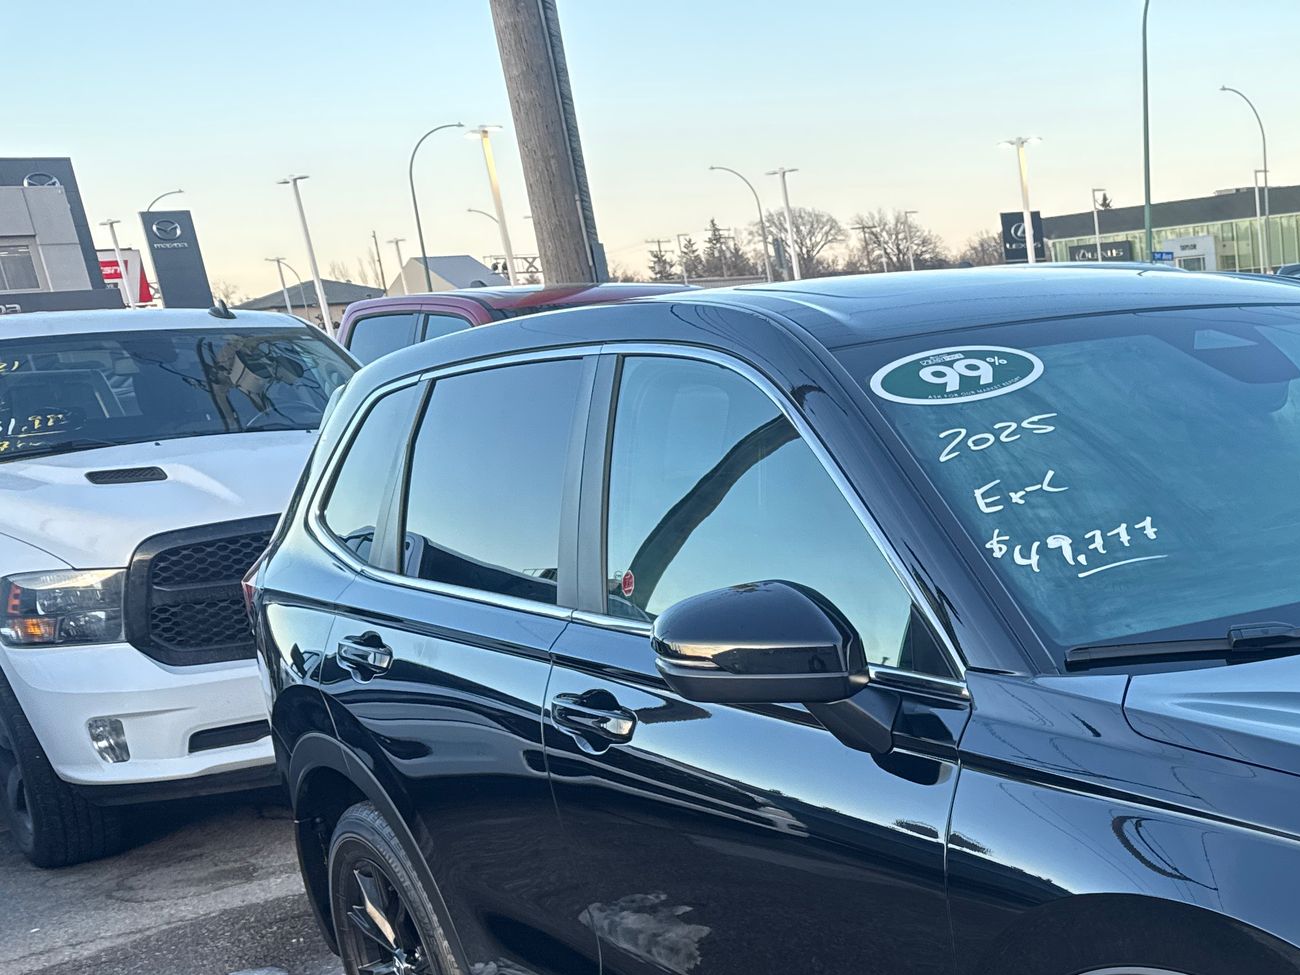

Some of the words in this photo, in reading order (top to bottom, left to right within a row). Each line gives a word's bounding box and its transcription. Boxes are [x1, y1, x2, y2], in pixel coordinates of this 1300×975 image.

[1006, 242, 1042, 250] LEXS
[918, 356, 1008, 393] 99%
[938, 412, 1058, 463] 2025
[985, 516, 1158, 574] $49,777
